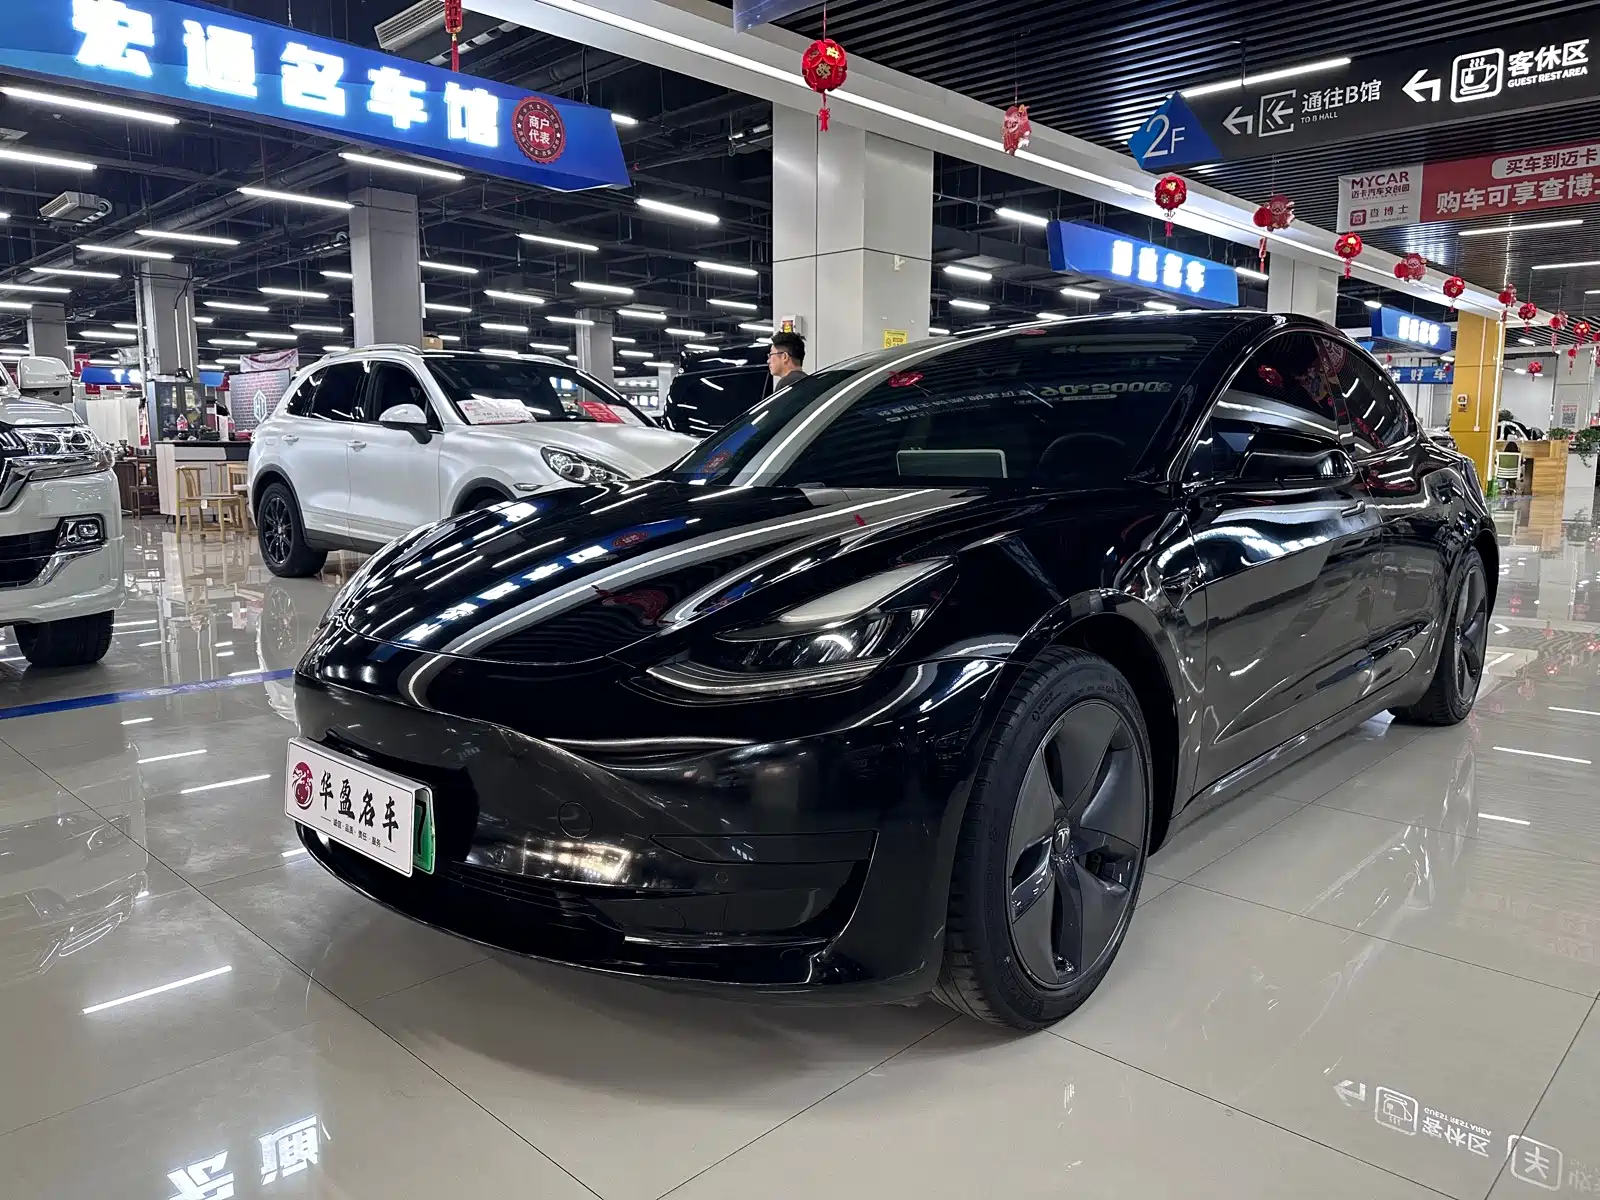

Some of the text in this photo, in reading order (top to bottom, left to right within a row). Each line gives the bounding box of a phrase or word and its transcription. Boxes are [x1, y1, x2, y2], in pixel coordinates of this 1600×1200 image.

[1507, 39, 1589, 77] 客休区
[71, 0, 500, 148] 宏通名车馆
[1507, 66, 1588, 88] GUEST REST AREA
[1301, 79, 1382, 113] 通往B馆
[528, 115, 550, 131] 商户
[1301, 111, 1338, 124] TO B HALL
[528, 129, 551, 145] 代表
[1142, 114, 1186, 159] 2F
[1505, 148, 1598, 176] 买车到迈卡
[1351, 171, 1409, 190] MYCAR
[1436, 172, 1600, 214] 购车可享查博
[319, 769, 400, 844] 华盈名车
